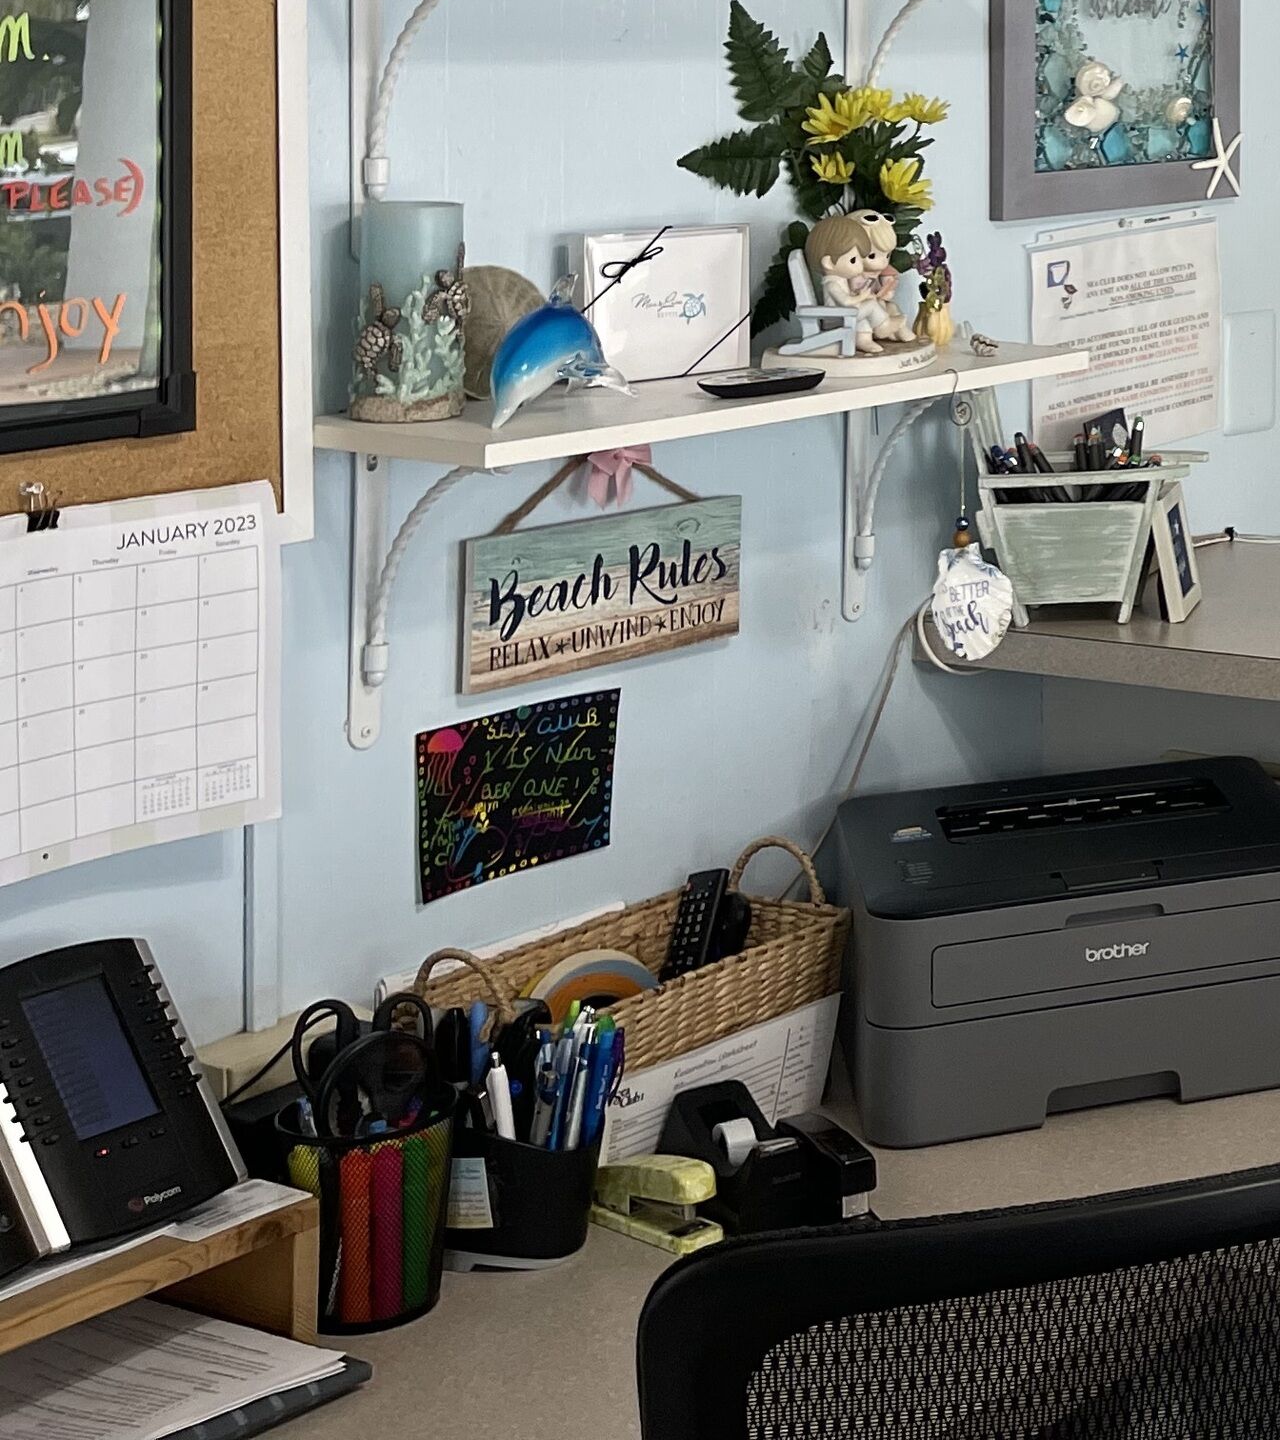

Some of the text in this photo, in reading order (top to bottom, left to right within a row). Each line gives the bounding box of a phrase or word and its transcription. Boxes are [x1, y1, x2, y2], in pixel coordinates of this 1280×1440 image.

[116, 514, 257, 550] JANUARY 2023
[489, 540, 726, 641] Beach Rules
[949, 580, 990, 603] BETTER
[489, 599, 725, 670] RELAX UNWIND ENJOY
[1085, 940, 1149, 963] brother
[144, 1186, 181, 1205] Polycom
